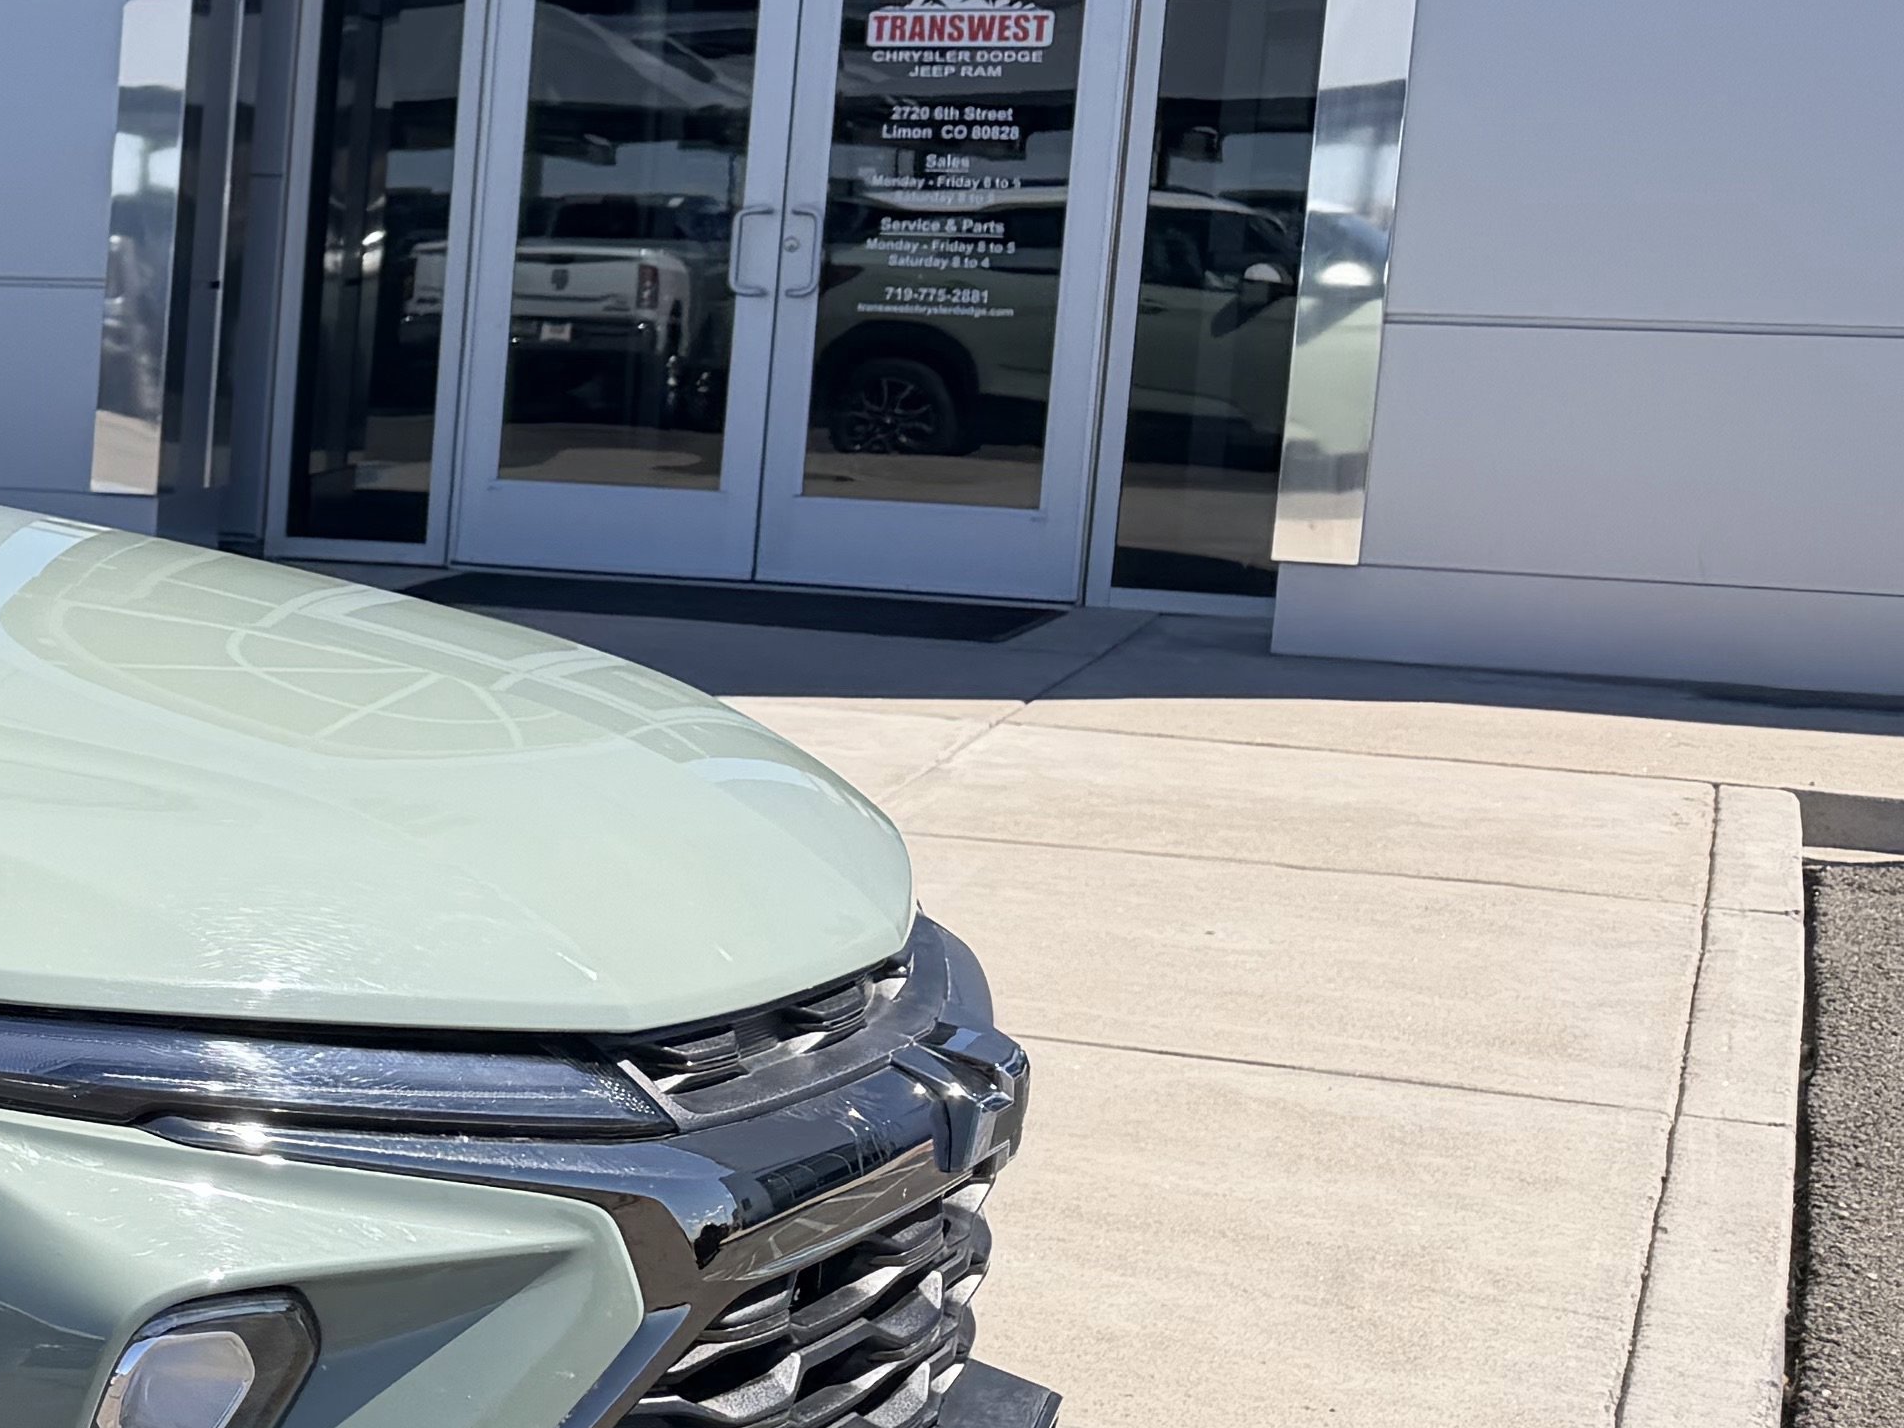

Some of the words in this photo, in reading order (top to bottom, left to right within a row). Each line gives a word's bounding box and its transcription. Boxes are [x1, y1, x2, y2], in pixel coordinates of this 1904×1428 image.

[873, 14, 1049, 42] TRANSWEST
[872, 50, 971, 62] CHRYSLER
[975, 50, 1043, 63] DODGE
[909, 65, 955, 77] JEEP
[960, 66, 1002, 77] RAM
[891, 106, 930, 120] 2720
[934, 106, 959, 121] 6th
[963, 107, 1013, 122] Street
[881, 124, 933, 139] Limon
[941, 125, 967, 140] CO
[925, 153, 970, 169] Sales
[871, 174, 925, 190] Monday
[936, 175, 980, 190] Friday
[995, 176, 1009, 189] to
[880, 217, 941, 232] Service
[945, 218, 957, 233] &
[962, 219, 1005, 234] Parts
[865, 238, 920, 253] Monday
[931, 239, 974, 255] Friday
[989, 241, 1004, 253] to
[888, 254, 948, 270] Saturday
[963, 257, 978, 269] to
